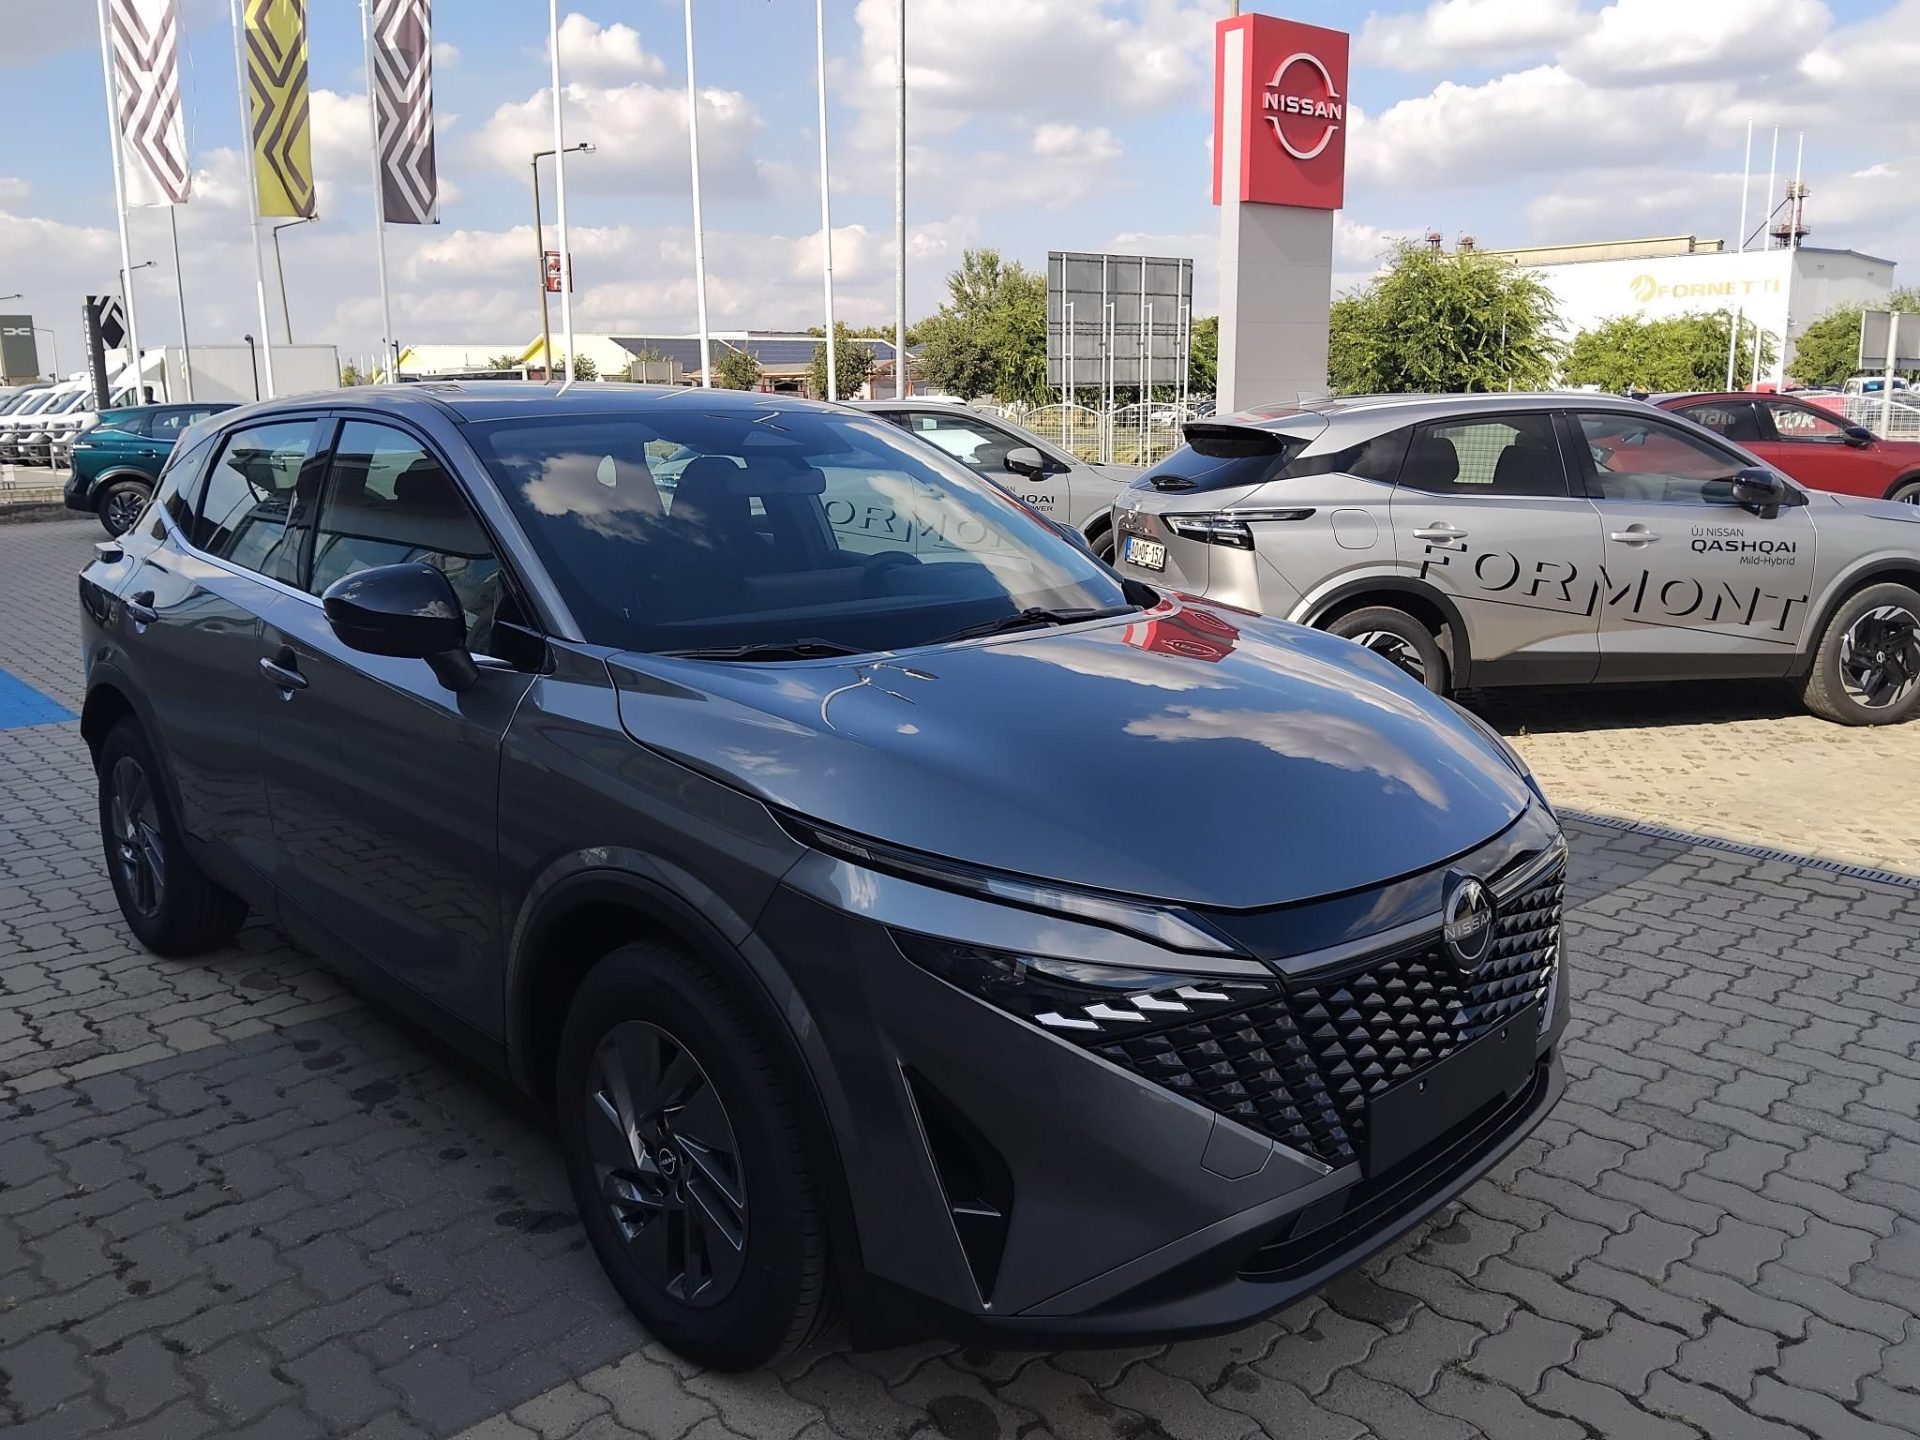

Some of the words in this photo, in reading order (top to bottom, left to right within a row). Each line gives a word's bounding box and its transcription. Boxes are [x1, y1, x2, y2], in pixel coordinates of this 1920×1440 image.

[1262, 91, 1343, 120] NISSAN
[1691, 525, 1704, 537] ÚJ
[1706, 527, 1744, 537] NISSAN
[1691, 539, 1797, 555] QASHQAI
[1739, 556, 1796, 567] Mild-Hybrid
[1420, 543, 1809, 632] FORMONT
[1444, 908, 1492, 941] NISSAN
